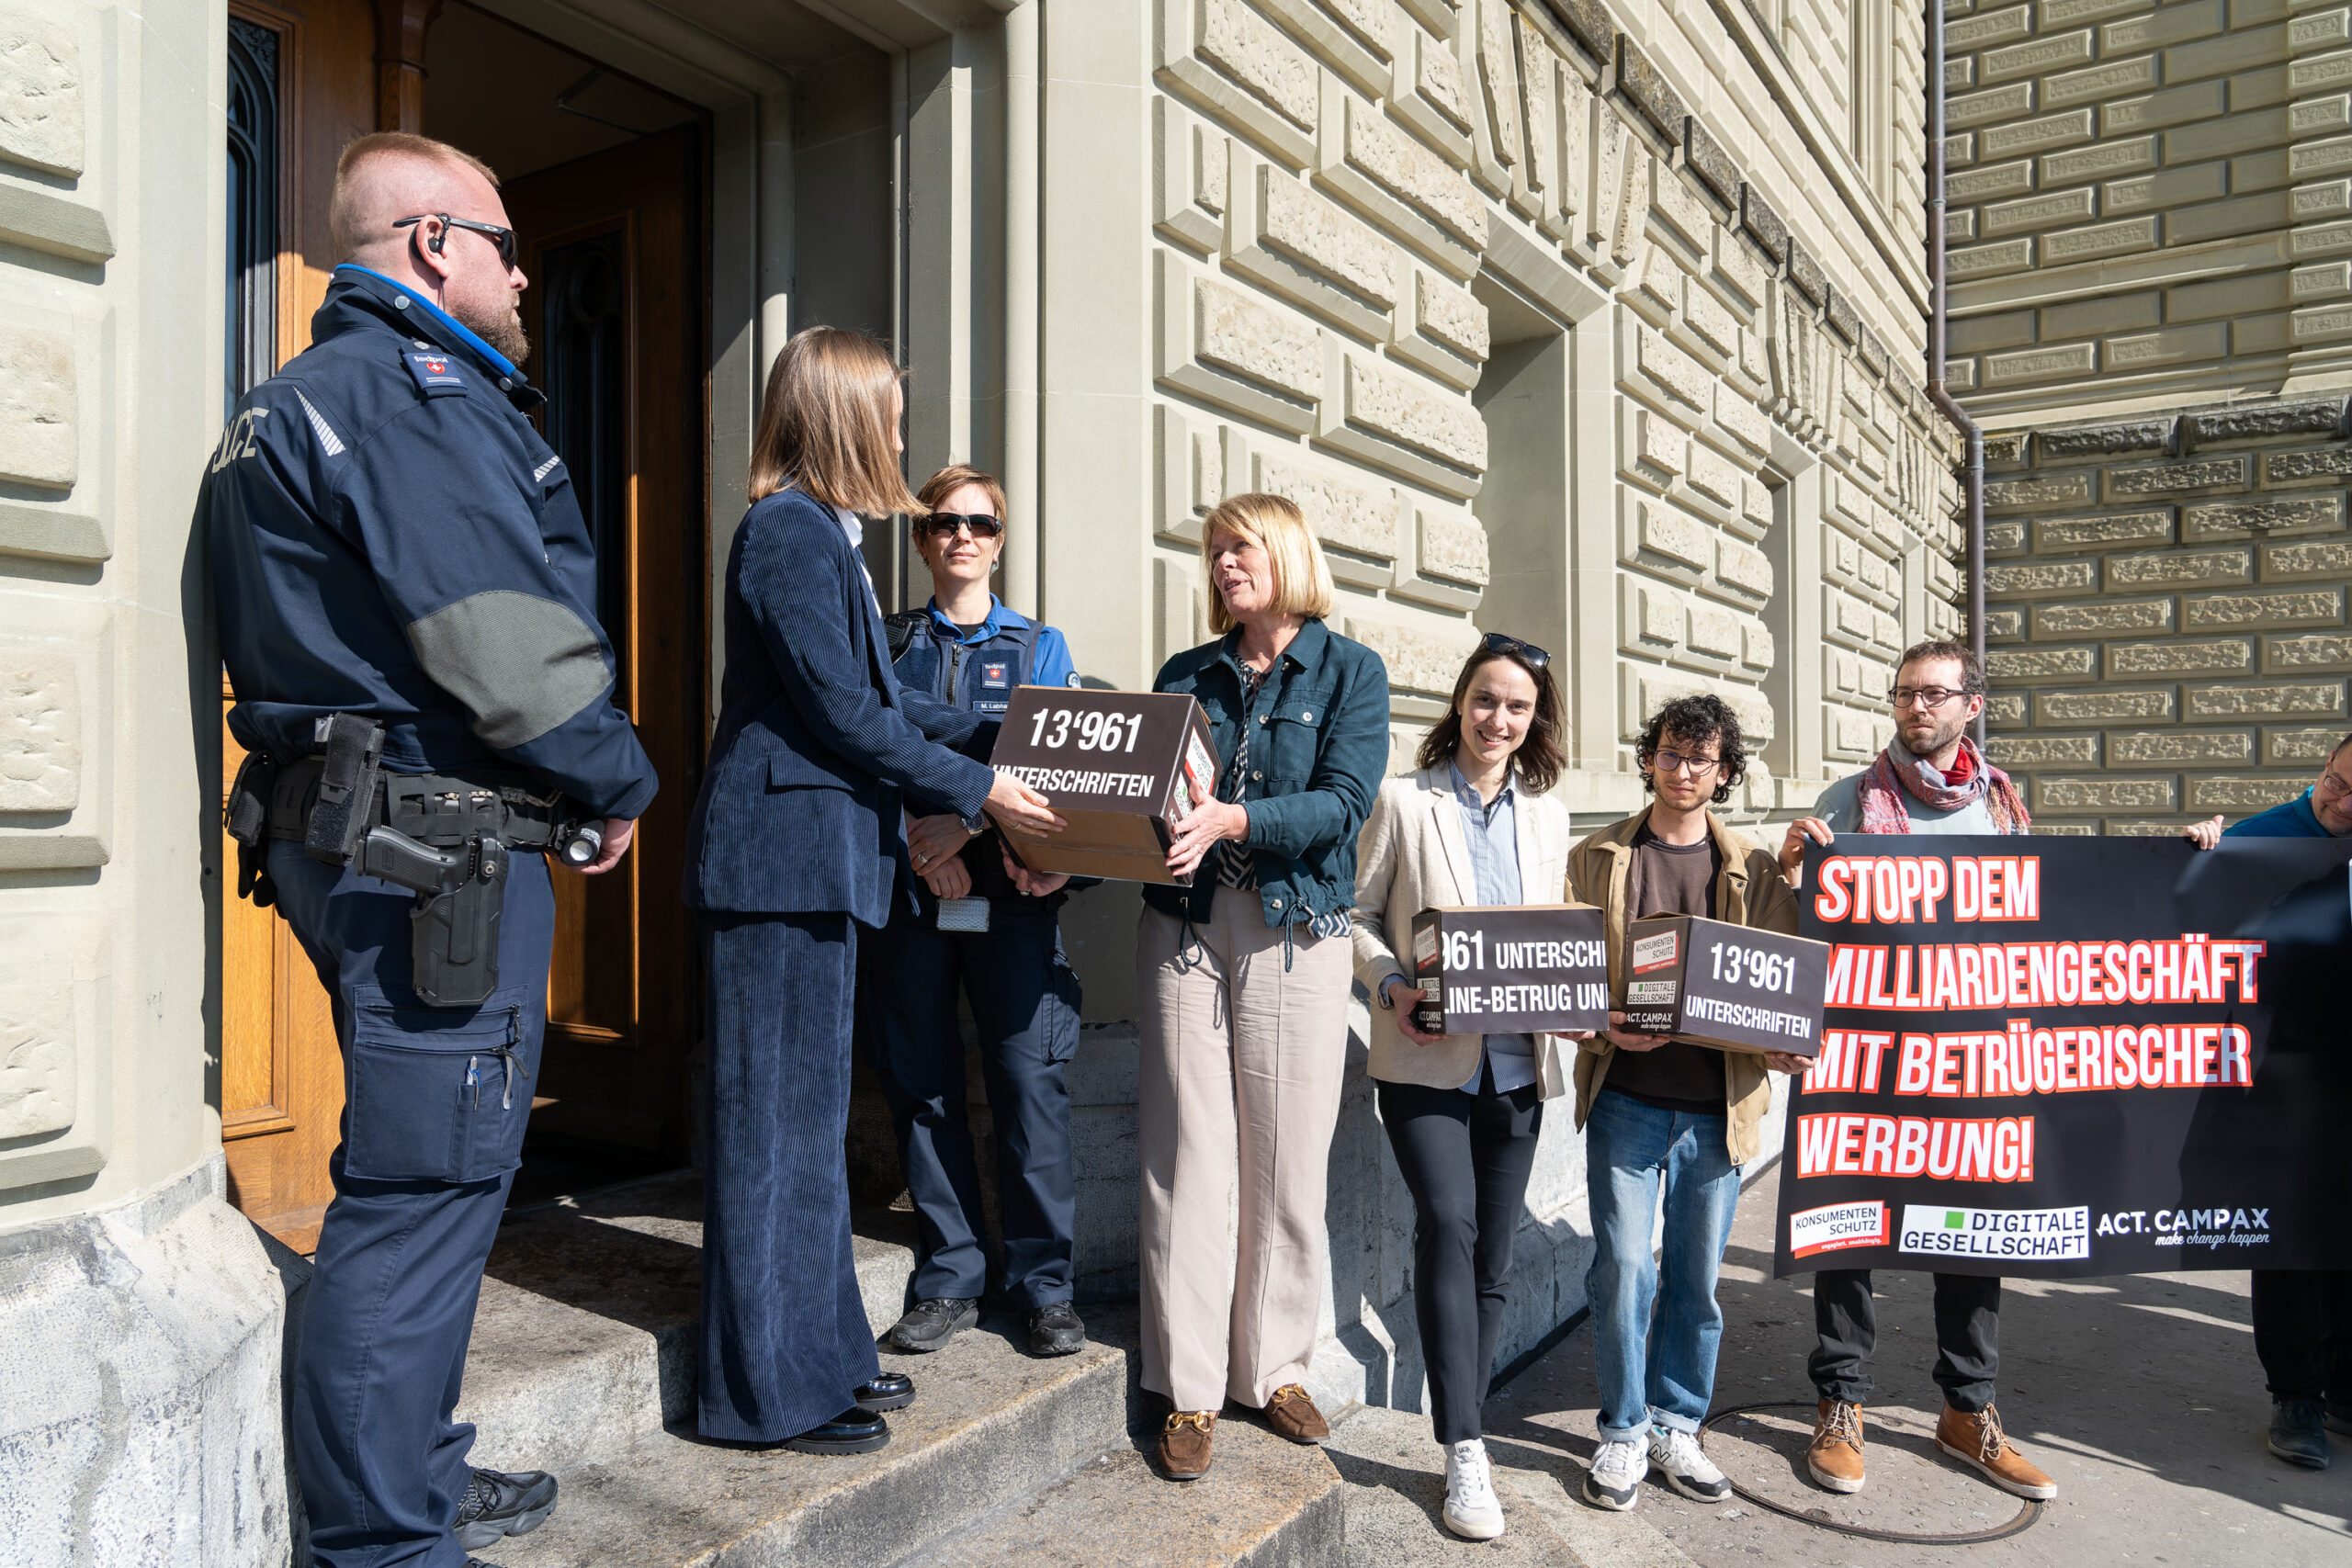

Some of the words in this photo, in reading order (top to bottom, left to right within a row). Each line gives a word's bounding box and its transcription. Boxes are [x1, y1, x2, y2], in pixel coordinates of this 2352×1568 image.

[413, 355, 449, 364] fedpol
[1816, 857, 1947, 922] STOPP
[1954, 858, 2038, 920] DEM
[1635, 935, 1675, 953] KONSUMENTEN
[1652, 946, 1674, 959] SCHUTZ
[1628, 993, 1675, 1003] GESELLSCHAFT
[1644, 982, 1676, 992] DIGITALE
[1444, 983, 1572, 1014] INE-BETRUG
[1641, 1012, 1673, 1023] CAMPAX
[1685, 994, 1812, 1039] UNTERSCHRIFTEN
[1804, 1032, 1892, 1091] MIT
[1898, 1021, 2250, 1094] BETRÜGERISCHER
[1799, 1115, 2032, 1179] WERBUNG!
[1794, 1207, 1877, 1229] KONSUMENTEN
[1829, 1220, 1876, 1235] SCHUTZ
[1971, 1210, 2086, 1233] DIGITALE
[2095, 1211, 2151, 1236] ACT.
[2154, 1208, 2270, 1232] CAMPAX
[1904, 1231, 2086, 1256] GESELLSCHAFT
[2154, 1230, 2185, 1247] make
[2186, 1230, 2226, 1250] change
[2227, 1230, 2269, 1247] happen
